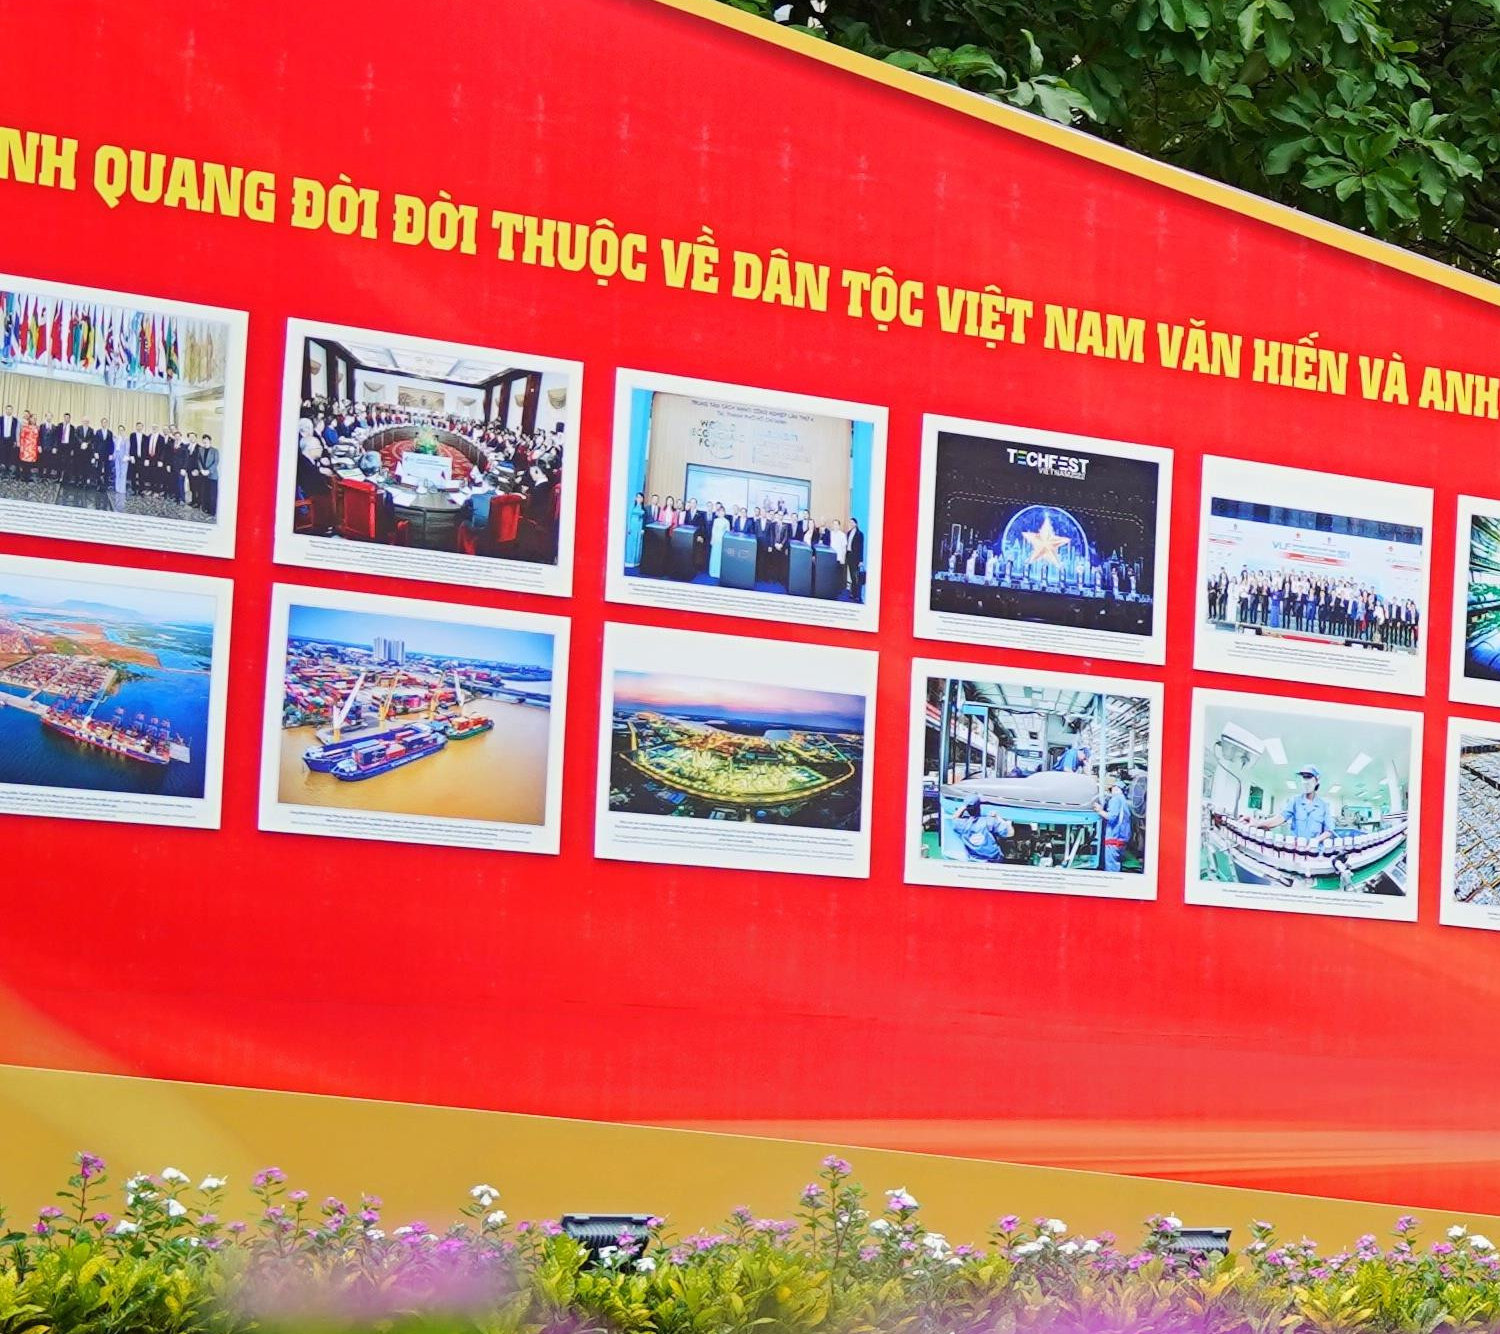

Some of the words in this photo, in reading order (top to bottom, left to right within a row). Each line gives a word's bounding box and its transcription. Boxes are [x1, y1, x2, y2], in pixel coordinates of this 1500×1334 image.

[93, 143, 276, 223] QUANG
[291, 172, 380, 239] ĐỜI
[392, 189, 479, 255] ĐỜI
[491, 209, 647, 286] THUỘC
[660, 224, 719, 294] VỀ
[731, 247, 830, 312] DÂN
[841, 265, 924, 332] TỘC
[936, 283, 1034, 349] VIỆT
[1043, 302, 1146, 364] NAM
[1156, 317, 1243, 379] VĂN
[1252, 330, 1349, 396] HIẾN
[1358, 351, 1409, 405] VÀ
[1418, 365, 1500, 420] ANH
[1006, 447, 1090, 474] TECHFEST
